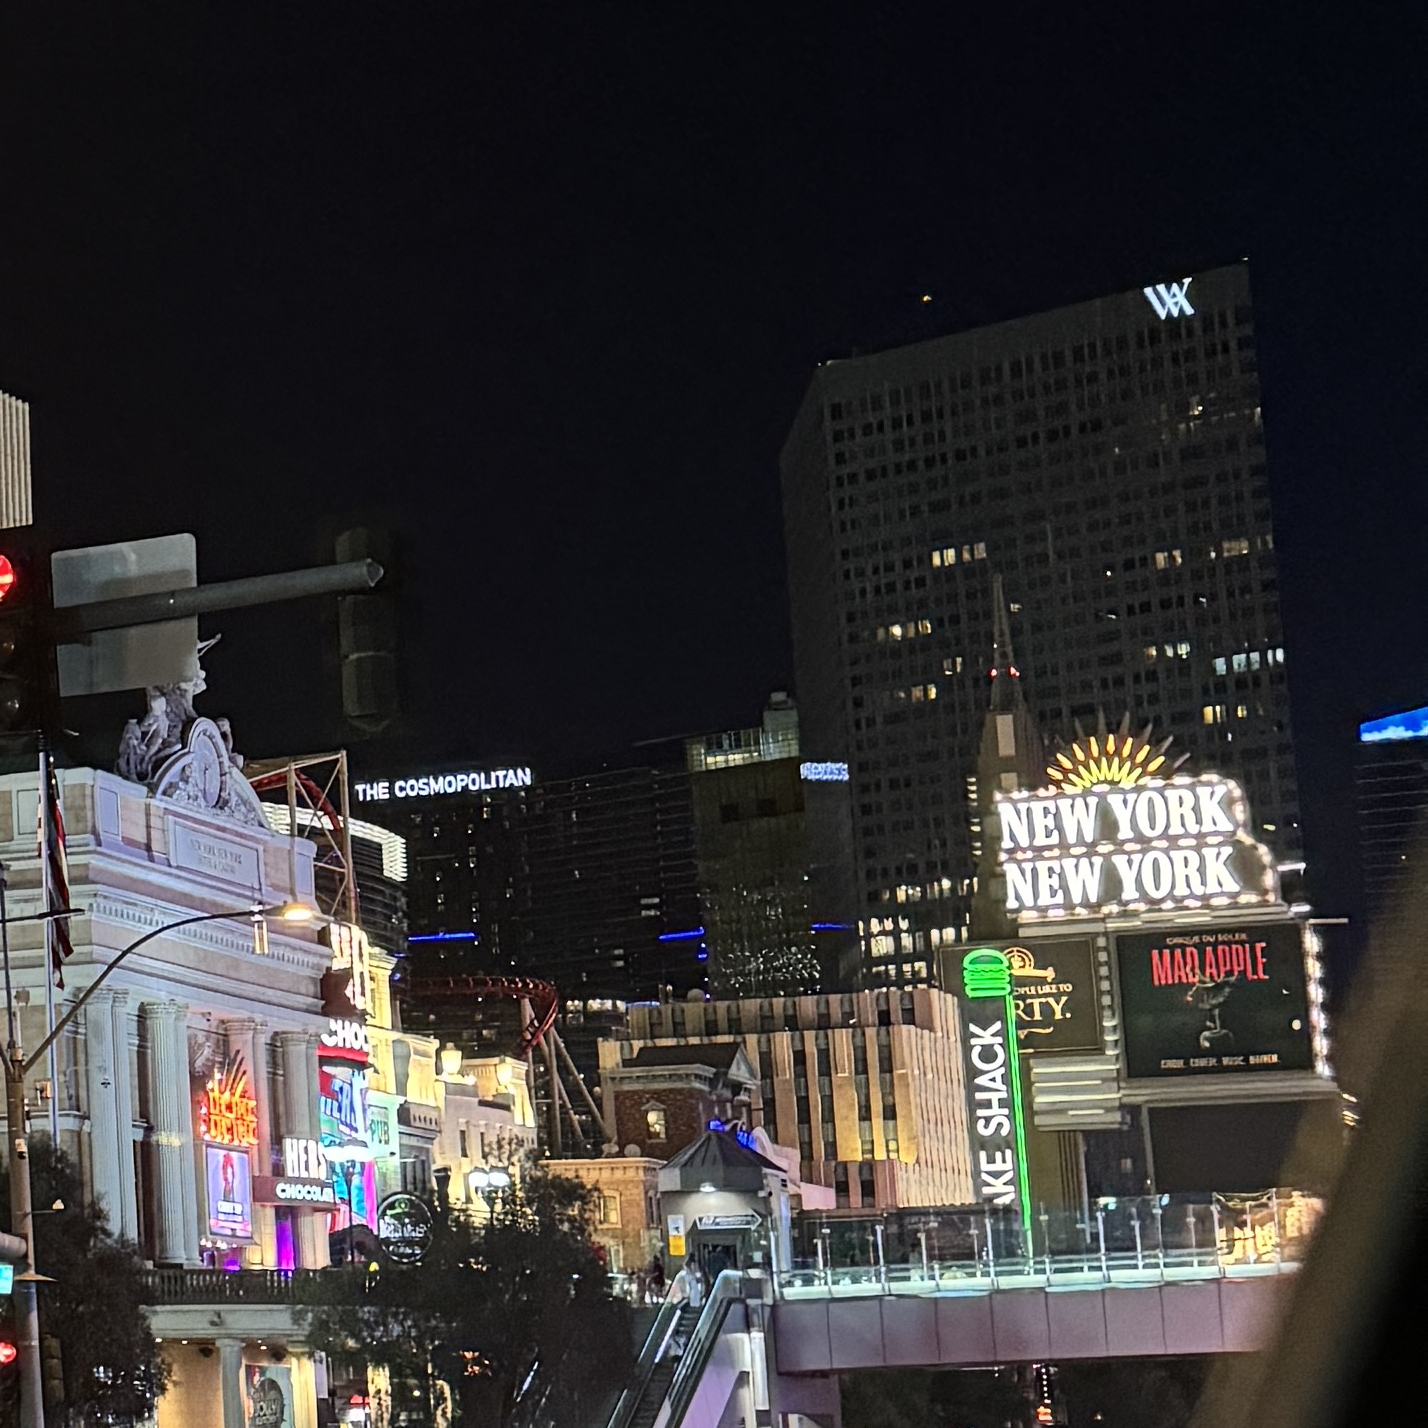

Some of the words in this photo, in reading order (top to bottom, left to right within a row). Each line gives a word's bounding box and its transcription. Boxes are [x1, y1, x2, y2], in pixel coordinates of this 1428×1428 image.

[355, 782, 390, 802] THE
[394, 768, 532, 798] COSMOPOLITAN
[997, 796, 1099, 849] NEW
[1107, 785, 1233, 840] YORK
[1003, 856, 1103, 909] NEW
[1111, 846, 1240, 901] YORK
[1151, 947, 1199, 987] MAD
[1204, 942, 1269, 983] APPLE
[969, 1021, 1012, 1137] SHACK
[370, 1119, 390, 1146] PUB
